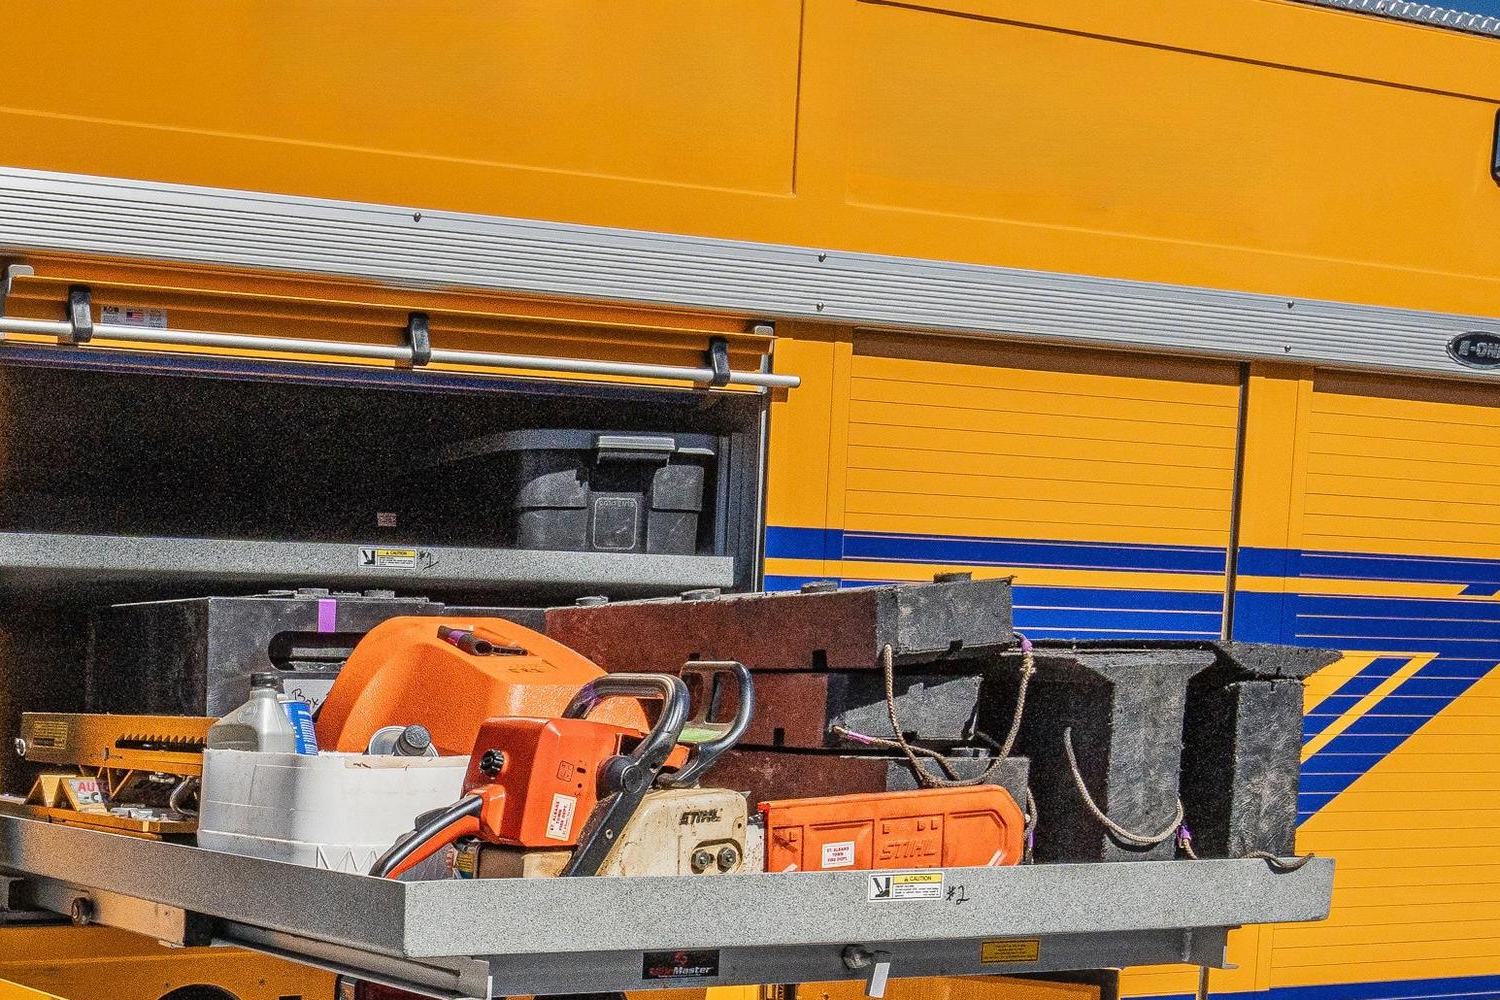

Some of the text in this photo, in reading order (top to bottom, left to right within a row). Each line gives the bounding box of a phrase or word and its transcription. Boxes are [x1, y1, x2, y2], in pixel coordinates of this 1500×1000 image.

[1459, 340, 1500, 359] E-ON
[679, 809, 721, 826] STIHL
[880, 841, 936, 860] STIHL
[946, 885, 970, 905] #2
